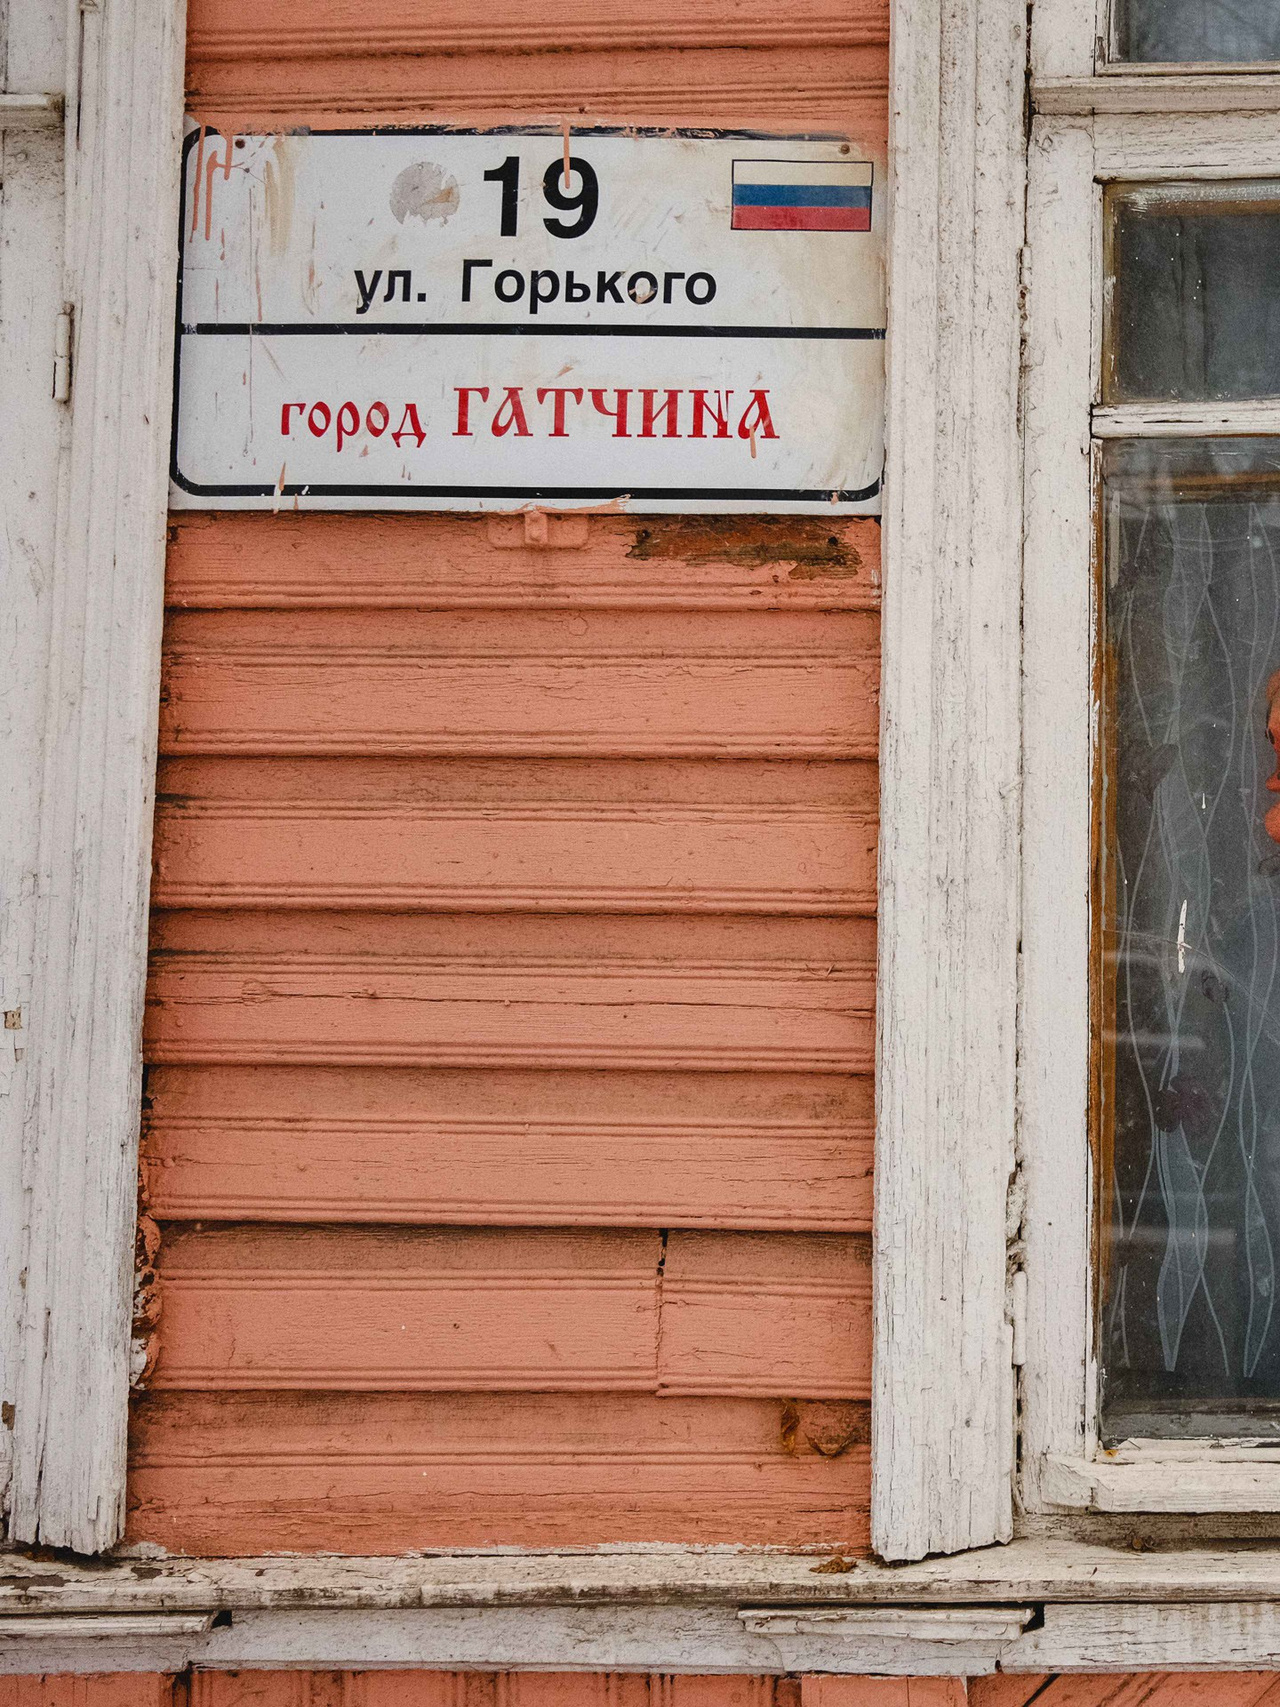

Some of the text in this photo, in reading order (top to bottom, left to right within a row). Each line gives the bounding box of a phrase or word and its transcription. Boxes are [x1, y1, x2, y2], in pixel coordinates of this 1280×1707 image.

[482, 156, 600, 239] 19
[354, 259, 717, 314] ул. Горького
[280, 386, 780, 453] город ГАТЧИНА
